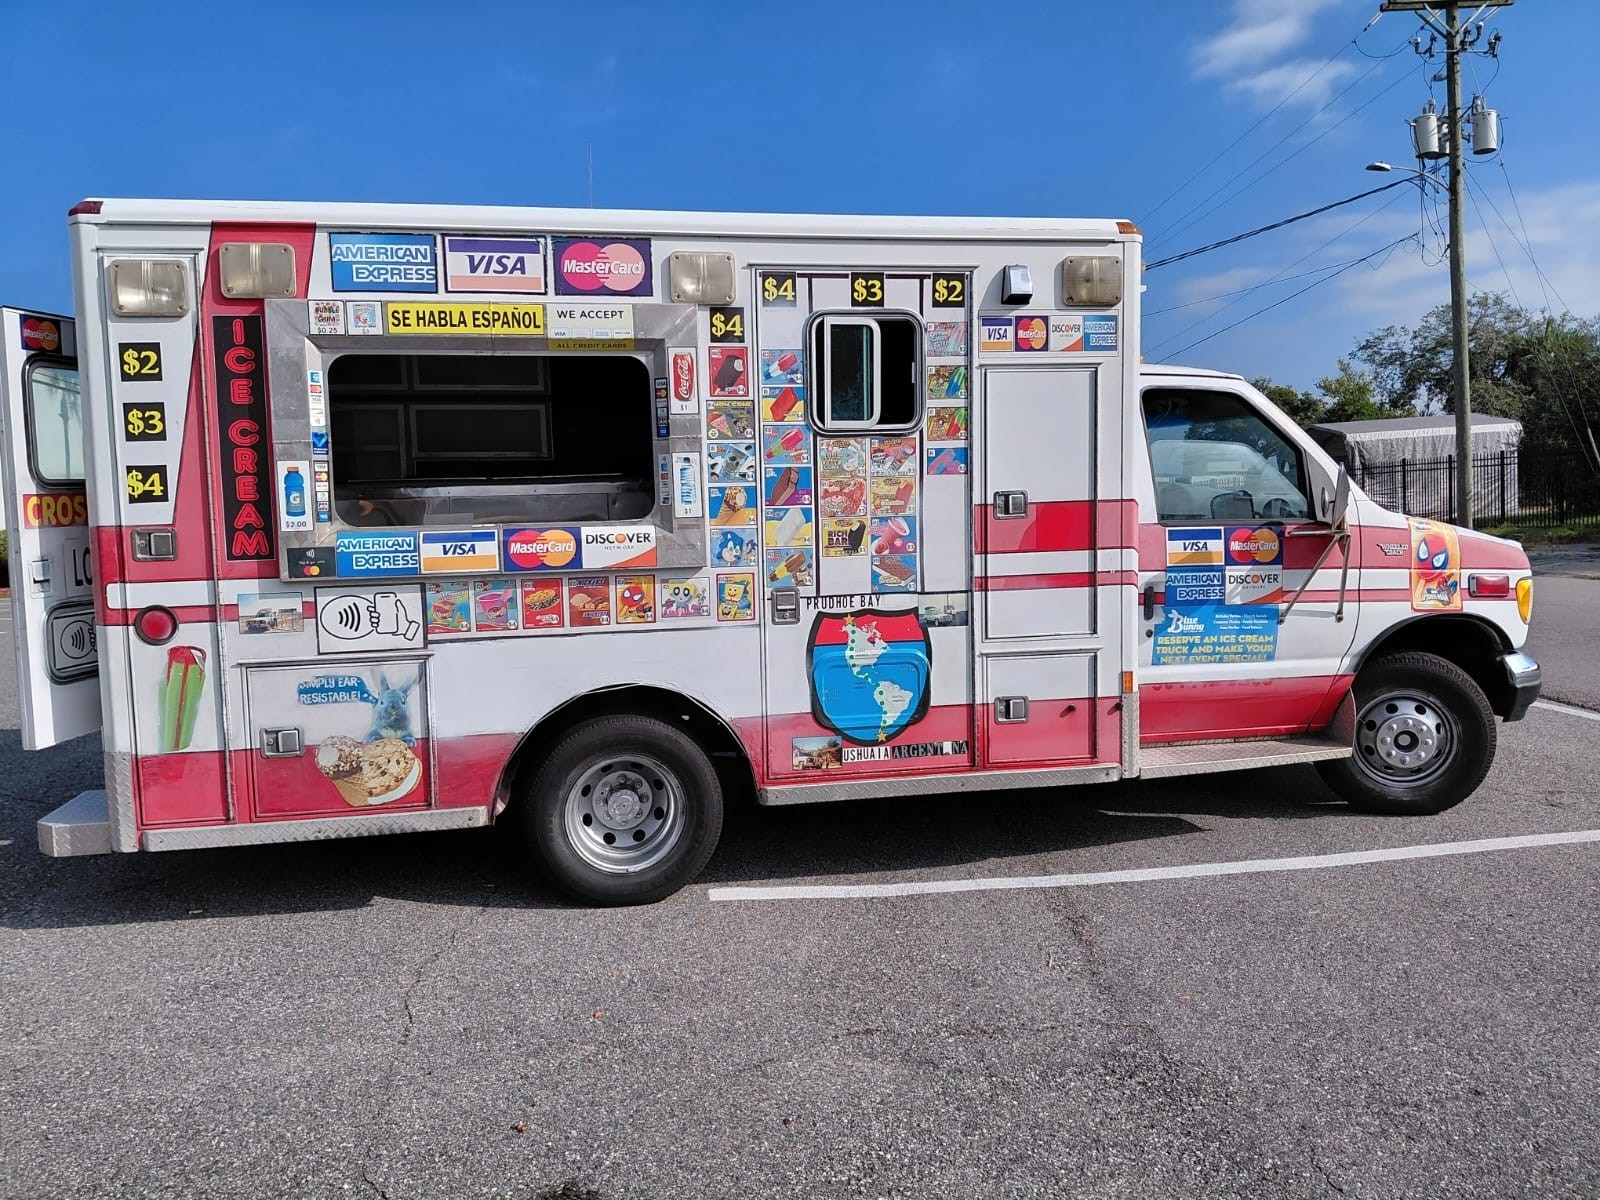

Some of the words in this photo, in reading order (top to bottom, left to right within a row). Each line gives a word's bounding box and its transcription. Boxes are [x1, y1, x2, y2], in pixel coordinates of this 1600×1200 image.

[332, 244, 430, 262] AMERICAN
[466, 254, 526, 275] VISA
[563, 259, 642, 275] MasterCard
[352, 264, 436, 283] EXPRESS
[764, 277, 795, 302] $4
[853, 277, 883, 302] $3
[934, 278, 964, 302] $2
[391, 310, 411, 328] SE
[416, 310, 467, 328] HABLA
[472, 307, 541, 329] ESPAÑOL
[556, 310, 576, 319] WE
[580, 310, 625, 319] ACCEPT
[711, 312, 744, 338] $4
[1052, 324, 1081, 333] DISCOVER
[1084, 321, 1115, 332] AMERICAN
[23, 328, 58, 341] MasterCard
[987, 327, 1008, 341] VISA
[1017, 329, 1047, 339] MasterCard
[1090, 334, 1118, 346] EXPRESS
[122, 348, 160, 376] $2
[224, 318, 256, 405] ICE
[127, 408, 164, 435] $3
[127, 469, 164, 498] $4
[228, 419, 270, 556] CREAM
[26, 495, 87, 527] CROS
[285, 520, 307, 528] $2.00
[586, 532, 651, 545] DISCOVER
[827, 530, 848, 538] RICH
[337, 536, 414, 552] AMERICAN
[510, 540, 574, 554] MasterCard
[827, 538, 849, 546] BAR
[1183, 541, 1207, 552] VISA
[1231, 541, 1277, 551] MasterCard
[442, 543, 476, 556] VISA
[353, 554, 418, 570] EXPRESS
[1166, 572, 1221, 586] AMERICAN
[1228, 573, 1279, 585] DISCOVER
[1177, 588, 1225, 601] EXPRESS
[806, 595, 855, 610] PRUDHOE
[860, 594, 881, 607] BAY
[1157, 635, 1201, 645] RESERVE
[1203, 635, 1218, 643] AN
[1220, 634, 1236, 643] ICE
[1238, 634, 1273, 643] CREAM
[1155, 646, 1189, 654] TRUCK
[1191, 645, 1213, 653] AND
[1215, 644, 1243, 653] MAKE
[1246, 644, 1274, 652] YOUR
[1160, 655, 1187, 665] NEXT
[1189, 654, 1221, 664] EVENT
[1223, 653, 1267, 663] SPECIAL!
[299, 690, 361, 704] RESISTABLE!
[843, 749, 890, 762] USHUAIA
[894, 743, 968, 759] ARGENTNA
